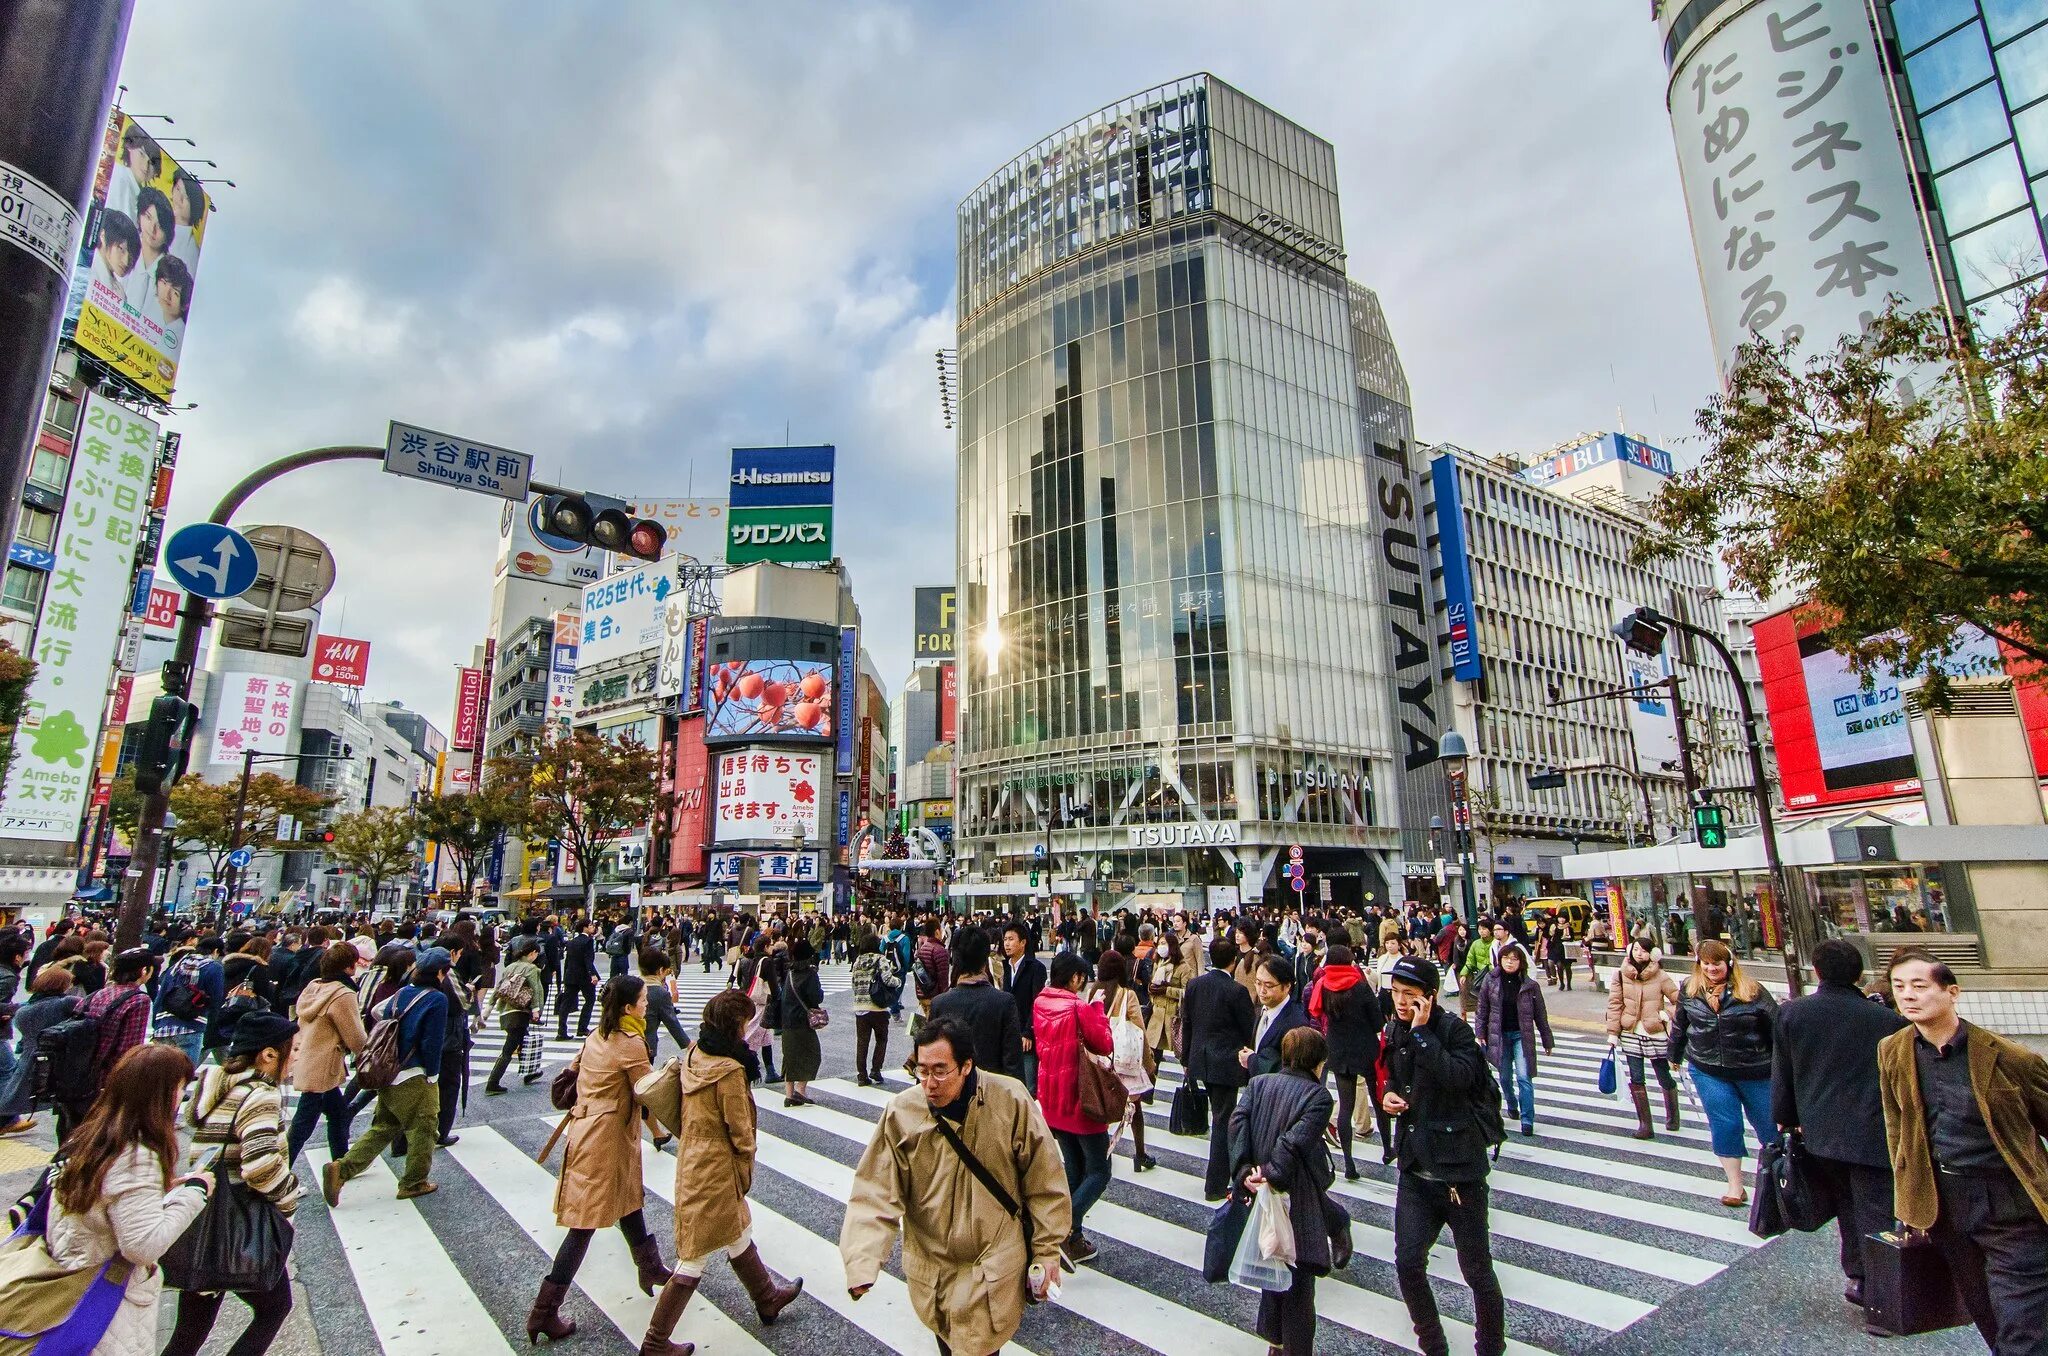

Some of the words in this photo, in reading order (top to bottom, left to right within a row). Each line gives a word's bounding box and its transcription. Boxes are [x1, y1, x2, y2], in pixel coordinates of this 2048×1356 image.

[3, 173, 24, 194] 視
[61, 211, 74, 228] 庁
[94, 280, 122, 304] HAPPY
[122, 302, 142, 319] NEW
[142, 315, 164, 336] YEAR
[83, 329, 101, 346] one
[86, 304, 119, 341] Sexy
[121, 329, 157, 367] Zone
[400, 432, 521, 480] 渋谷駅前
[1531, 442, 1605, 487] SEIBU
[1626, 440, 1669, 473] SEIBU
[417, 461, 472, 484] Shibuya
[477, 474, 504, 491] Sta.
[730, 467, 831, 485] Hisamitsu
[105, 421, 151, 565] 交換日記、
[731, 522, 826, 545] サロンパス
[39, 406, 123, 687] 20年ぶりに大流行。
[572, 567, 598, 580] VISA
[585, 571, 652, 614] R25世代、
[1374, 438, 1440, 771] TSUTAYA
[556, 616, 580, 645] 本
[583, 615, 621, 645] 集合。
[711, 626, 729, 635] Mighty
[1449, 601, 1471, 667] SEIBU
[324, 641, 361, 663] H&M
[661, 602, 685, 692] もんじゃ
[918, 634, 957, 652] FOR
[335, 665, 354, 673] この先
[335, 672, 360, 682] 150m
[557, 684, 575, 695] まで
[239, 677, 269, 743] 新聖地。
[268, 681, 293, 737] 女性の
[455, 670, 479, 747] Essential
[1836, 697, 1857, 714] KEN
[22, 767, 81, 786] Ameba
[722, 754, 816, 777] 信号待ちで
[720, 778, 746, 799] 出品
[1004, 771, 1085, 791] STARBUCKS
[1293, 769, 1372, 792] TSUTAYA
[18, 784, 78, 804] スマホ
[720, 801, 788, 821] できます。
[4, 817, 53, 830] アメーバ
[1132, 822, 1236, 846] TSUTAYA
